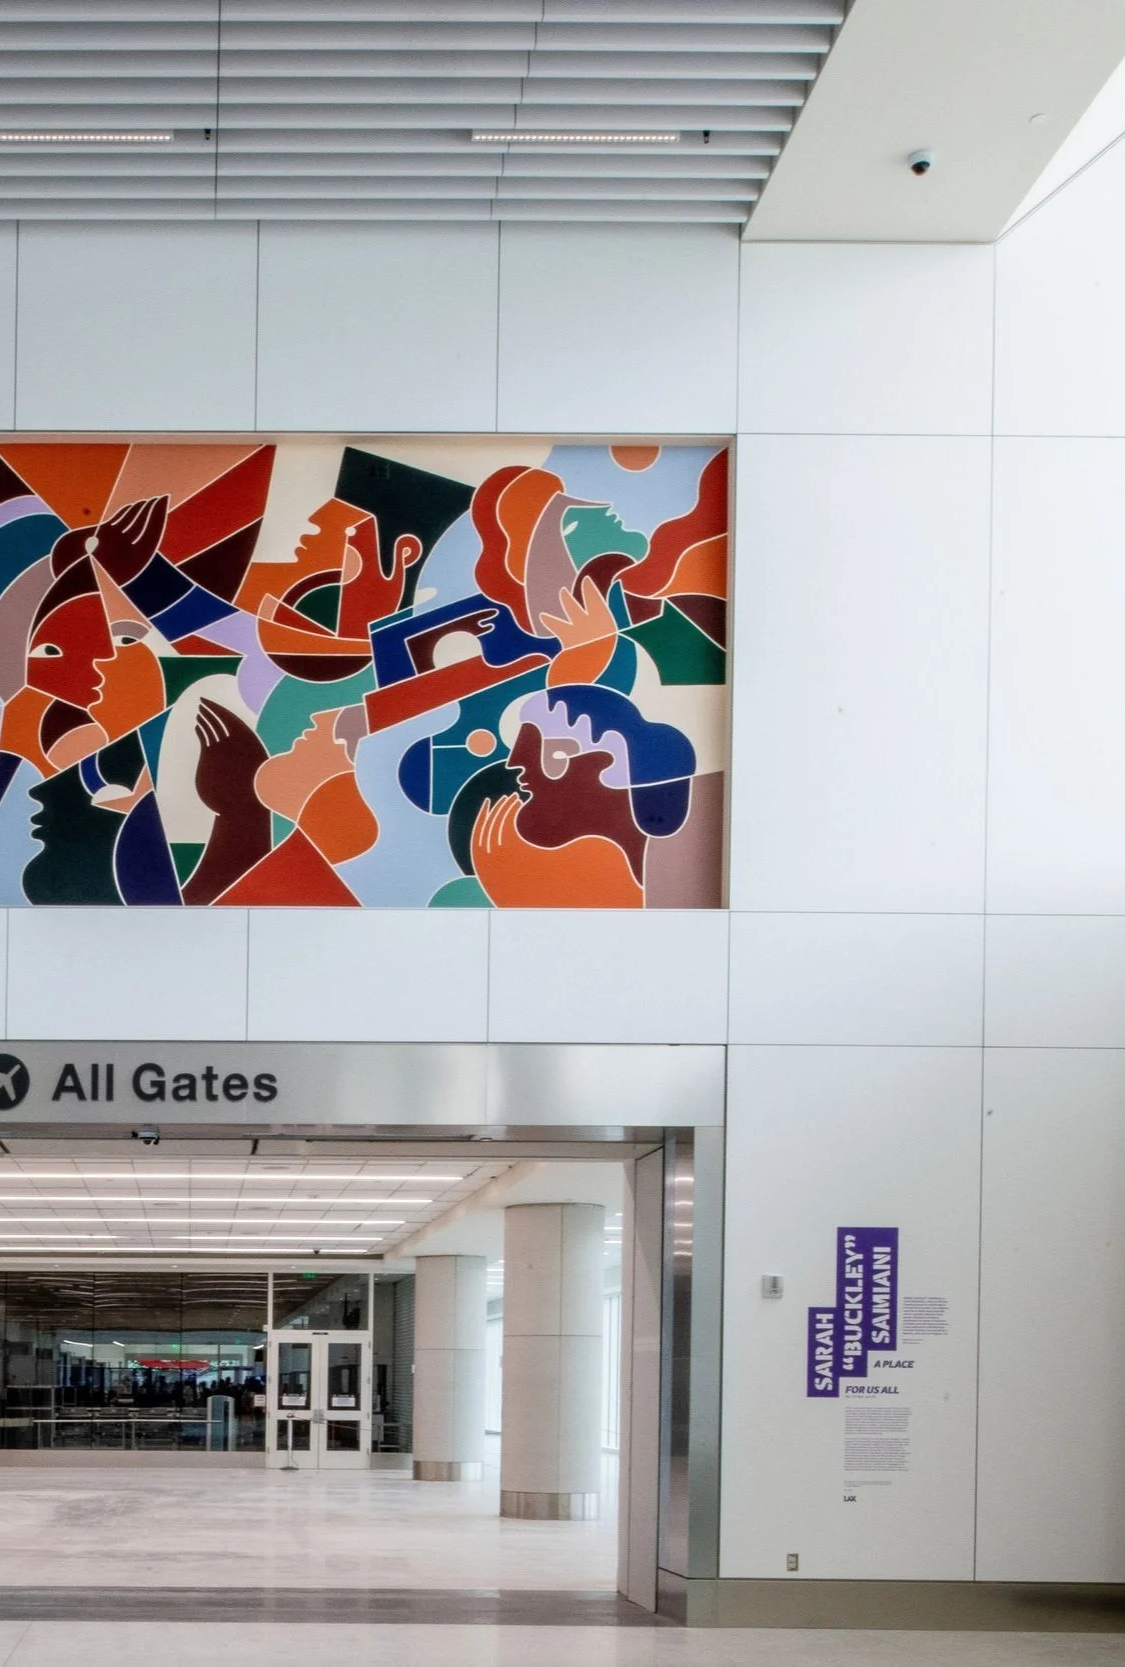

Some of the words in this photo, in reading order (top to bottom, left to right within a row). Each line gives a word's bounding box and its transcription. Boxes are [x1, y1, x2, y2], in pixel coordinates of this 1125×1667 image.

[51, 1062, 114, 1102] All
[131, 1061, 278, 1103] Gates
[871, 1246, 891, 1344] SAMIANI
[814, 1313, 834, 1391] SARAH
[874, 1360, 882, 1369] A
[883, 1360, 915, 1369] PLACE
[845, 1385, 866, 1394] FOR
[867, 1386, 880, 1394] US
[881, 1386, 900, 1395] ALL
[843, 1495, 857, 1503] LAX
